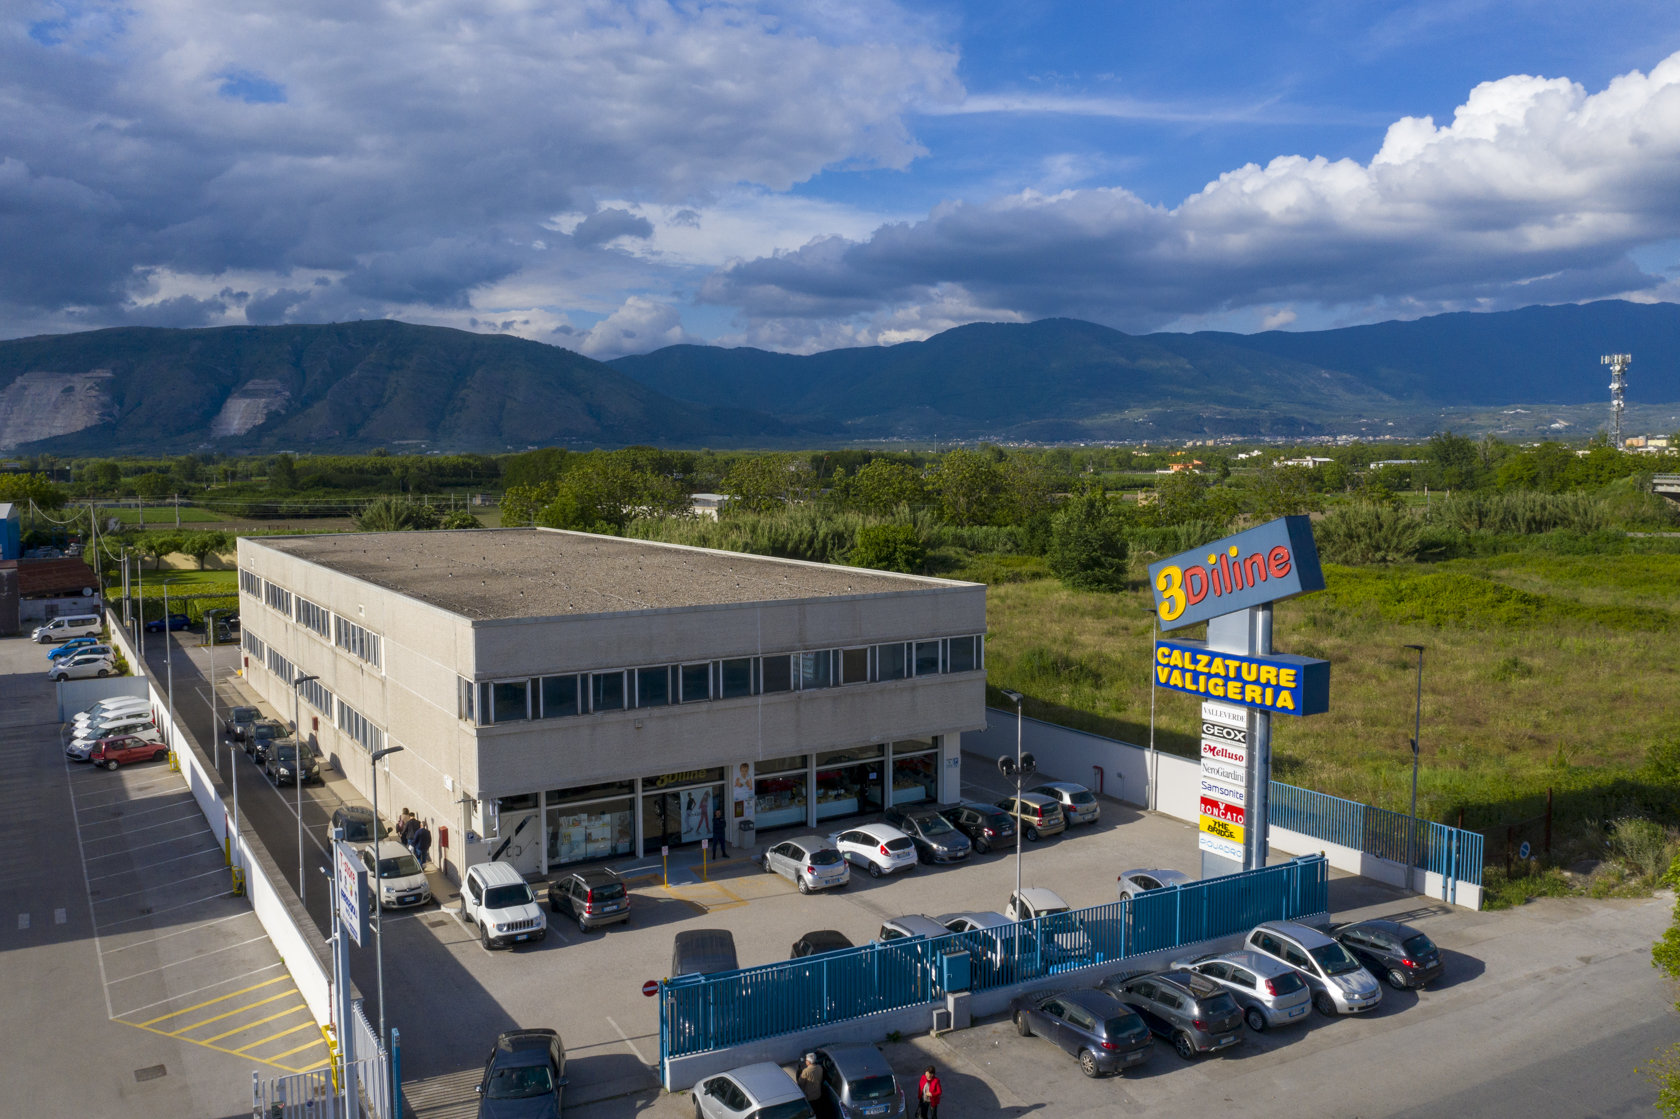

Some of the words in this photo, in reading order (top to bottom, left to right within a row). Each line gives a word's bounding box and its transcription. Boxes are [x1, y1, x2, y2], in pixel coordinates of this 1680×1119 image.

[1156, 545, 1291, 621] 3Diline
[1157, 647, 1297, 688] CALZATURE
[1156, 665, 1296, 710] VALIGERIA
[1203, 706, 1246, 723] VALLEVERDE
[1202, 723, 1246, 743] GEOX
[1203, 743, 1244, 762] Melluso
[1202, 762, 1244, 782] NeroGiardini
[1201, 780, 1244, 801] Samsonite
[1200, 803, 1244, 824] RONCATO
[1207, 825, 1236, 839] BRIDGE
[1212, 820, 1230, 831] THE
[1200, 838, 1243, 858] PIQUADRO
